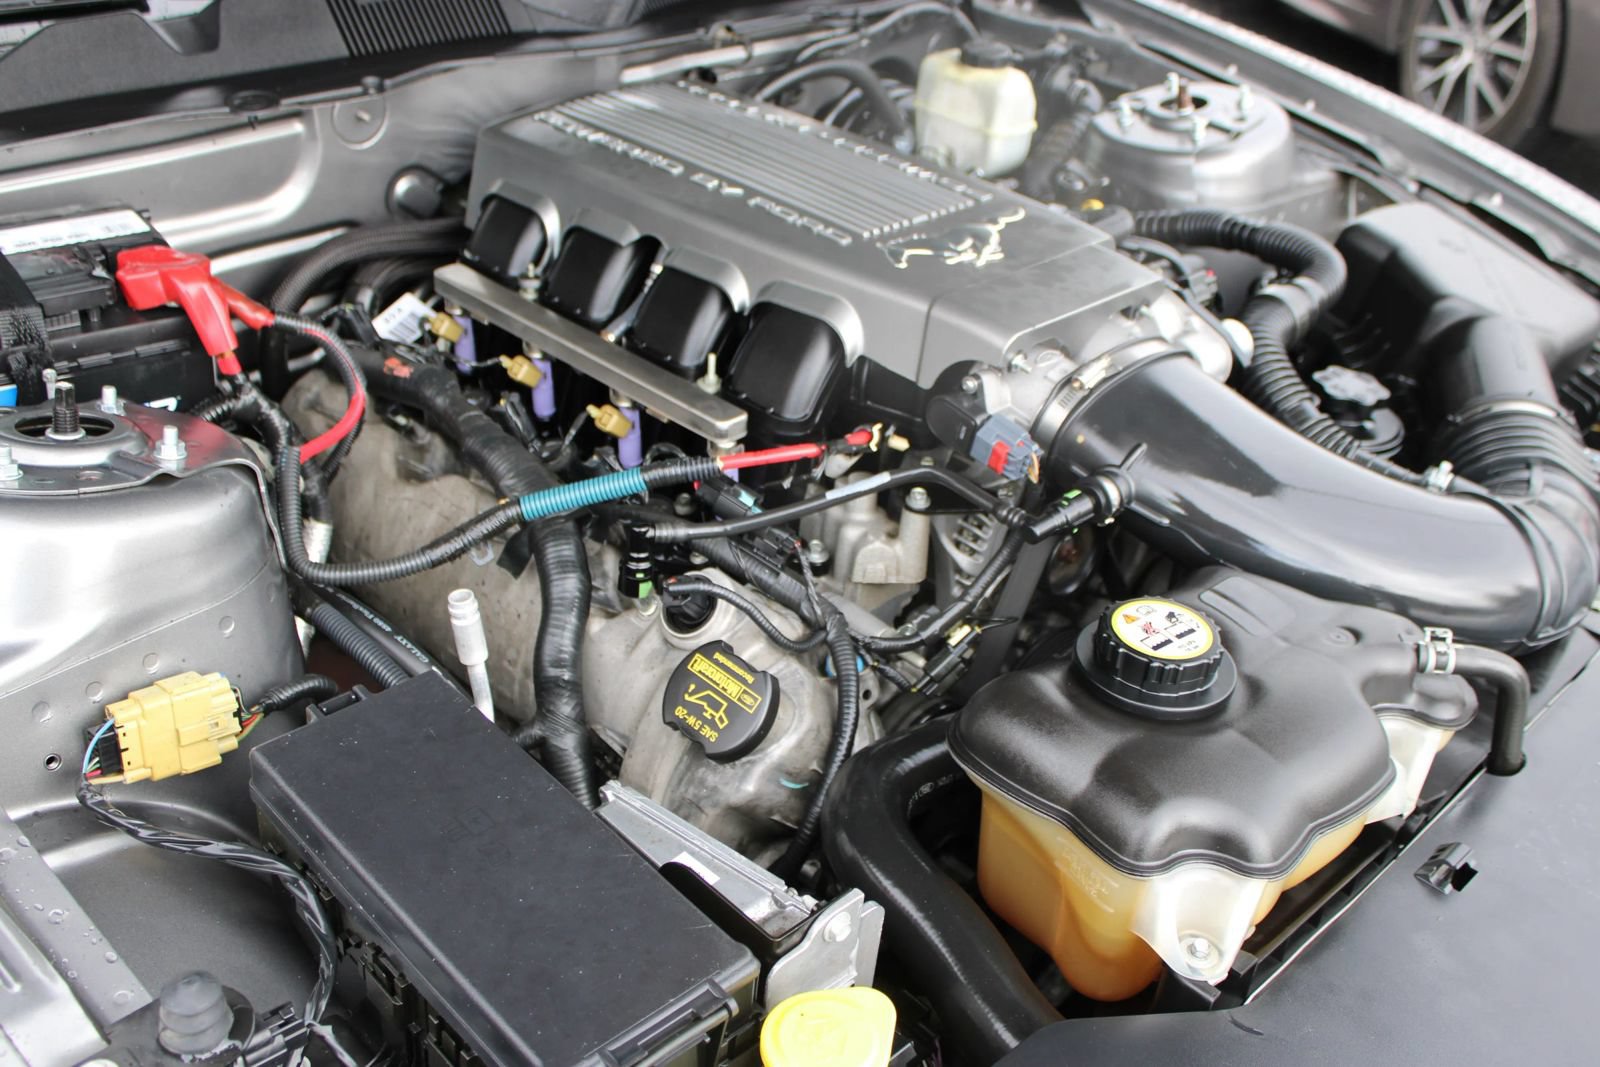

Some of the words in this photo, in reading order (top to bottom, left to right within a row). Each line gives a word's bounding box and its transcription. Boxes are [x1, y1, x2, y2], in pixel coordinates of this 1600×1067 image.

[747, 196, 852, 246] FORD
[394, 635, 430, 663] GALAXY
[692, 657, 741, 699] Motorcraft
[713, 652, 755, 684] Recommended
[674, 705, 702, 731] 5W-20
[700, 724, 719, 743] SAE
